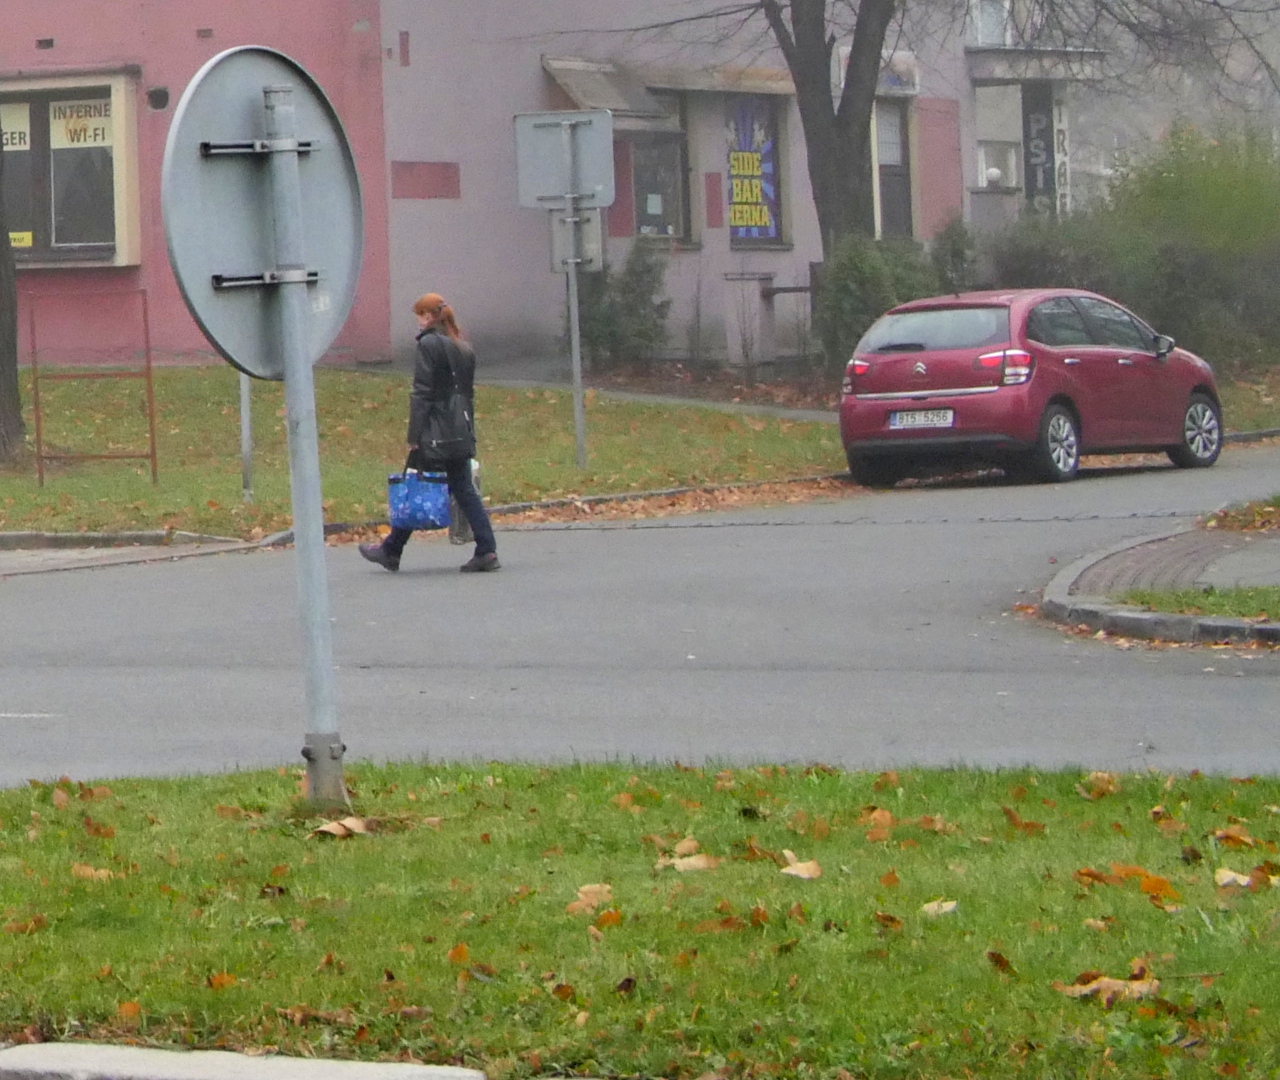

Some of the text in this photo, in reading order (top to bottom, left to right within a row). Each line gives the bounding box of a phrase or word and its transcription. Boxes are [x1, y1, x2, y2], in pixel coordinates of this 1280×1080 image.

[52, 103, 111, 120] INTERNE
[2, 131, 27, 146] GER
[68, 127, 106, 144] WI-FI
[729, 150, 762, 176] SIDE
[732, 179, 762, 202] BAR
